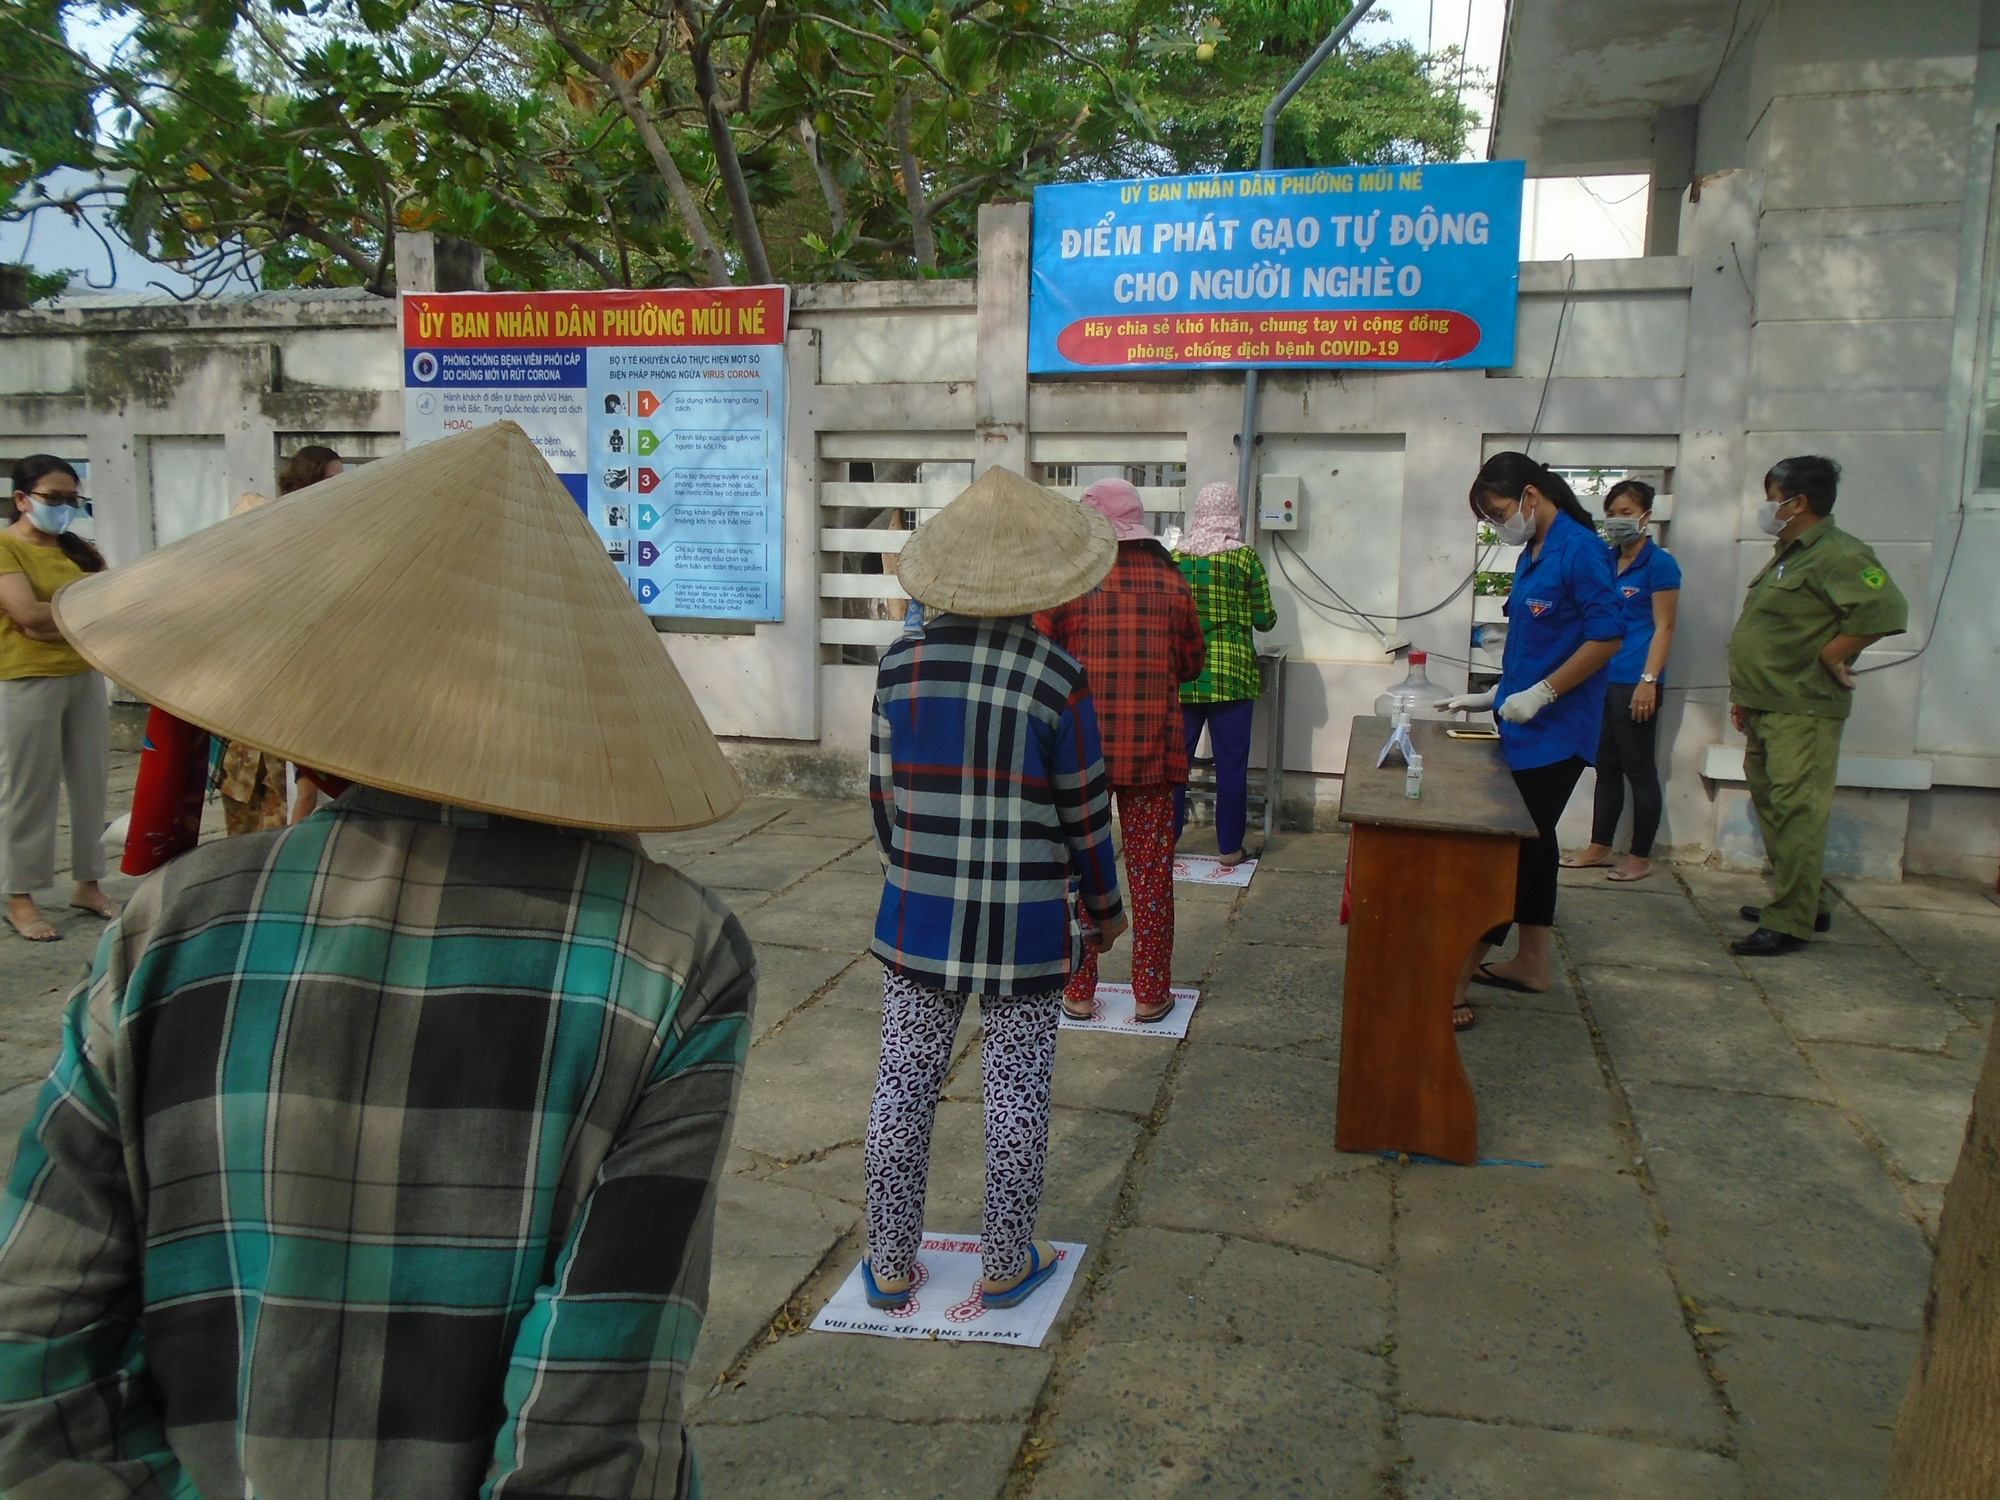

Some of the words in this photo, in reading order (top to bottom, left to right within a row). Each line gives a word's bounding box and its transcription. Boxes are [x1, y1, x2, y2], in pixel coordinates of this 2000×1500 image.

[1148, 183, 1181, 202] BAN
[1188, 176, 1234, 199] NHÂN
[1240, 174, 1275, 197] DÂN
[1281, 170, 1353, 194] PHƯỜNG
[1358, 168, 1393, 192] MŨI
[1399, 167, 1422, 190] NÉ
[1061, 211, 1141, 259] ĐIỂM
[1153, 213, 1240, 253] PHÁT
[1251, 216, 1320, 255] GẠO
[1331, 209, 1380, 253] TỰ
[1389, 205, 1489, 251] ĐỘNG
[1113, 271, 1179, 303] CHO
[1190, 260, 1290, 300] NGƯỜI
[1303, 257, 1422, 297] NGHÈO
[419, 302, 444, 338] ỦY
[451, 312, 489, 338] BAN
[496, 304, 549, 337] NHÂN
[555, 303, 596, 337] DÂN
[603, 302, 685, 336] PHƯỜNG
[692, 301, 731, 335] MŨI
[739, 300, 765, 335] NÉ
[1085, 322, 1112, 339] Hãy
[1117, 321, 1148, 336] chia
[1153, 318, 1170, 334] sẻ
[1176, 318, 1204, 334] khó
[1210, 318, 1254, 335] khăn,
[1259, 317, 1308, 334] chung
[1313, 317, 1338, 334] tay
[1344, 316, 1357, 331] vì
[1362, 316, 1403, 334] cộng
[1408, 314, 1450, 334] đồng
[1128, 344, 1178, 361] phòng,
[1184, 340, 1232, 358] chống
[1237, 341, 1270, 359] dịch
[1276, 341, 1315, 358] bệnh
[1320, 340, 1399, 356] COVID-19
[443, 353, 470, 365] PHÒNG
[472, 353, 498, 365] CHỐNG
[501, 354, 522, 368] BỆNH
[524, 353, 542, 365] VIÊM
[544, 352, 562, 365] PHỔI
[564, 352, 581, 365] CẤP
[610, 355, 620, 366] BỘ
[629, 355, 637, 364] TẾ
[640, 355, 669, 364] KHUYẾN
[671, 354, 686, 364] CÁO
[689, 356, 709, 366] THỰC
[712, 355, 729, 366] HIỆN
[731, 355, 747, 366] MỘT
[749, 353, 759, 363] SỐ
[443, 370, 454, 380] DO
[485, 369, 499, 380] MỚI
[501, 370, 508, 380] VI
[510, 368, 525, 380] RÚT
[527, 370, 561, 380] CORONA
[610, 370, 626, 380] BIỆN
[629, 369, 648, 379] PHÁP
[651, 369, 676, 379] PHÒNG
[679, 369, 700, 378] NGỪA
[703, 370, 725, 378] VIRUS
[727, 370, 759, 378] CORONA
[642, 398, 648, 410] 1
[545, 437, 561, 445] bệnh
[642, 437, 650, 448] 2
[642, 475, 650, 486] 3
[642, 511, 651, 523] 4
[642, 548, 651, 559] 5
[642, 586, 650, 597] 6
[960, 1243, 981, 1253] TRO
